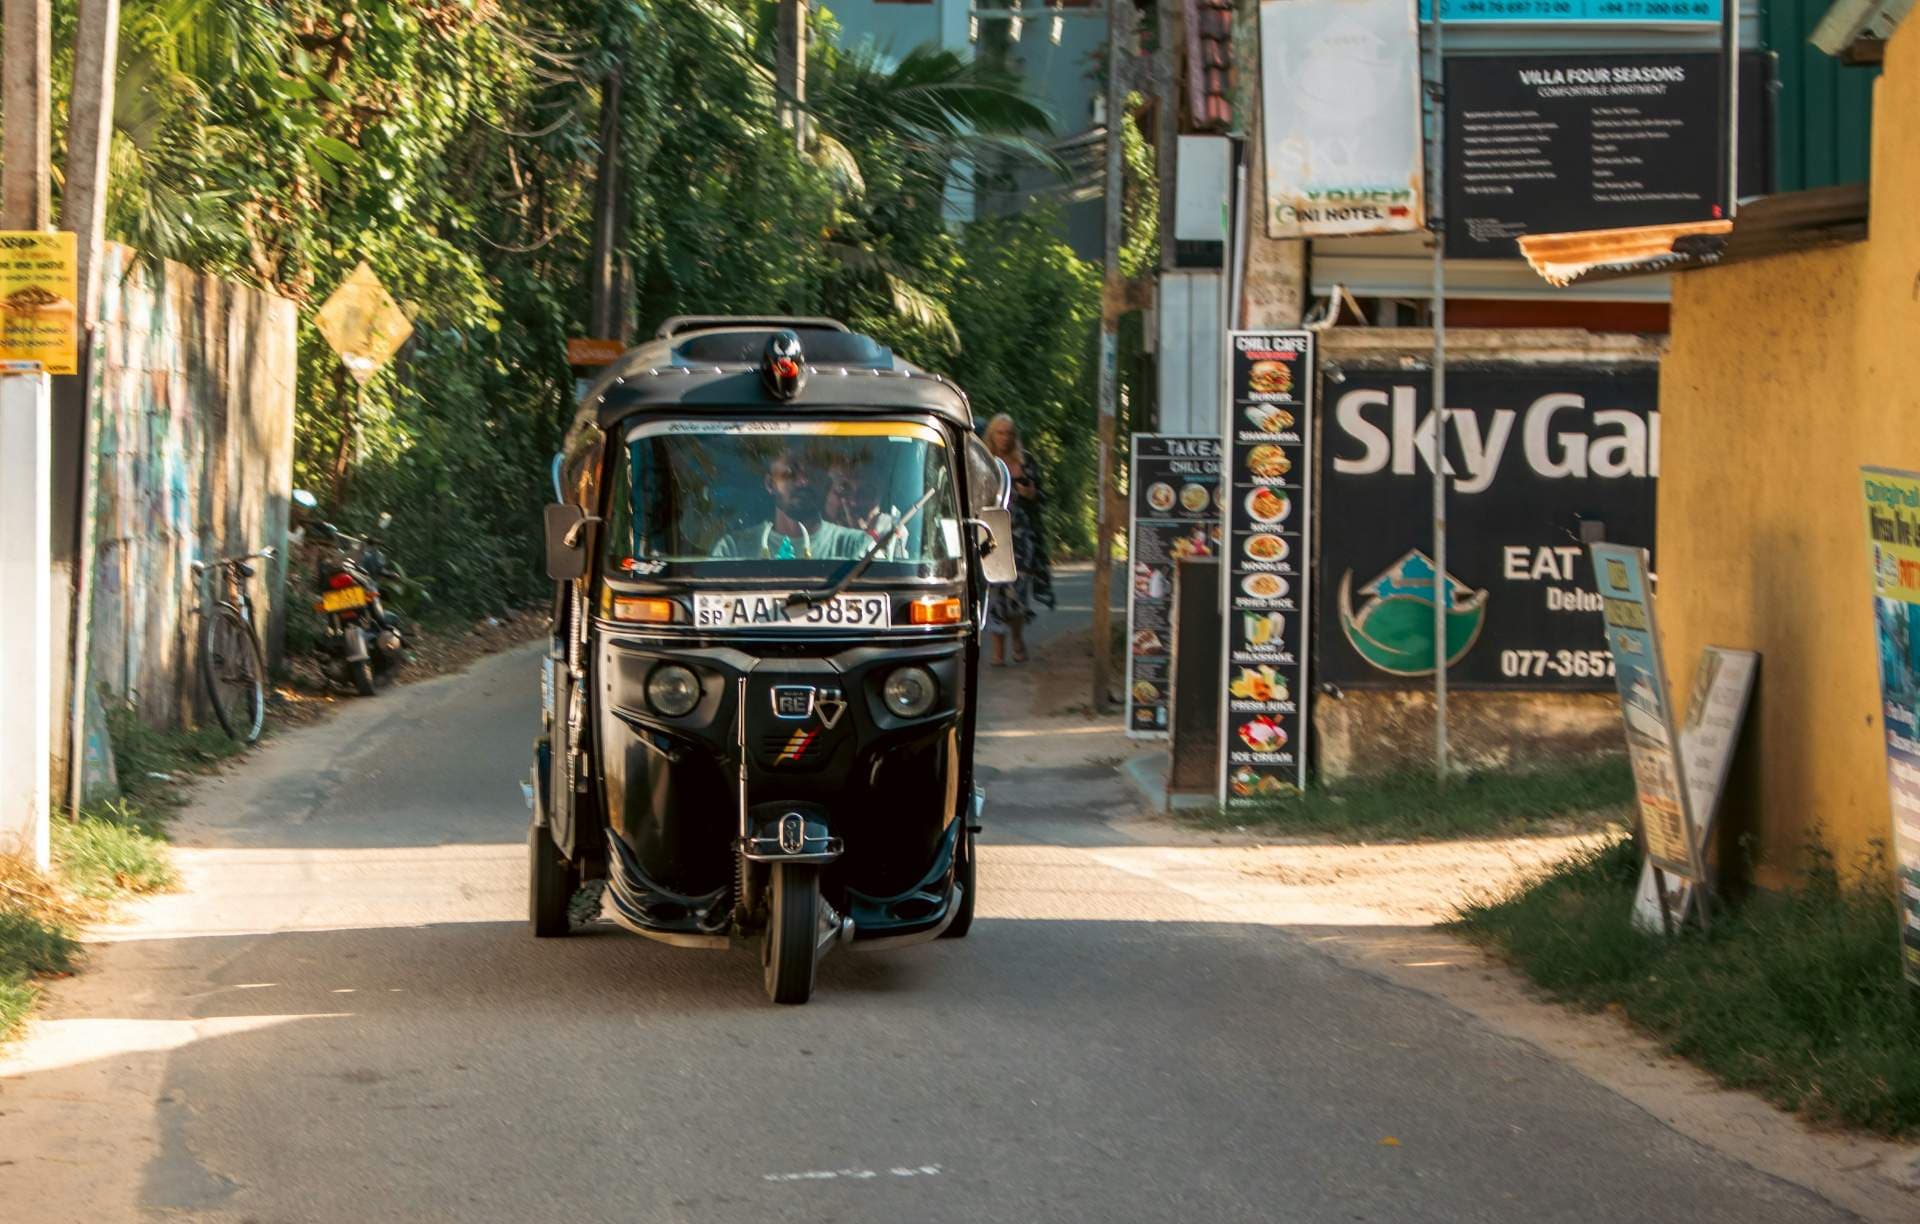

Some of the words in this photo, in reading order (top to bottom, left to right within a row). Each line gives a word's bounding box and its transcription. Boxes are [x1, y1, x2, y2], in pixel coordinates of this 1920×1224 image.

[1519, 68, 1566, 85] VILLA
[1566, 67, 1611, 84] FOUR
[1612, 65, 1686, 83] SEASONS
[1537, 84, 1609, 97] COMFORTABLE
[1609, 83, 1668, 95] APARTMENT
[1326, 206, 1384, 221] HOTEL
[1236, 336, 1273, 351] CHILL
[1273, 336, 1308, 352] CAFE
[1248, 390, 1293, 402] BURGER
[1238, 430, 1301, 442] SHAWARMA
[1333, 385, 1517, 494] Sky
[1169, 460, 1203, 474] CHILL
[1241, 560, 1292, 572] NOODLES
[1503, 546, 1583, 581] EAT
[1235, 597, 1268, 608] FRIED
[1269, 598, 1294, 609] RICE
[699, 609, 723, 625] SP
[806, 597, 883, 625] 5859
[1233, 651, 1295, 662] MILKSHAKE
[779, 697, 807, 713] RE
[1231, 700, 1266, 711] FRESH
[1266, 700, 1297, 712] JUICE
[1231, 751, 1250, 762] ICE
[1250, 751, 1294, 763] CREAM
